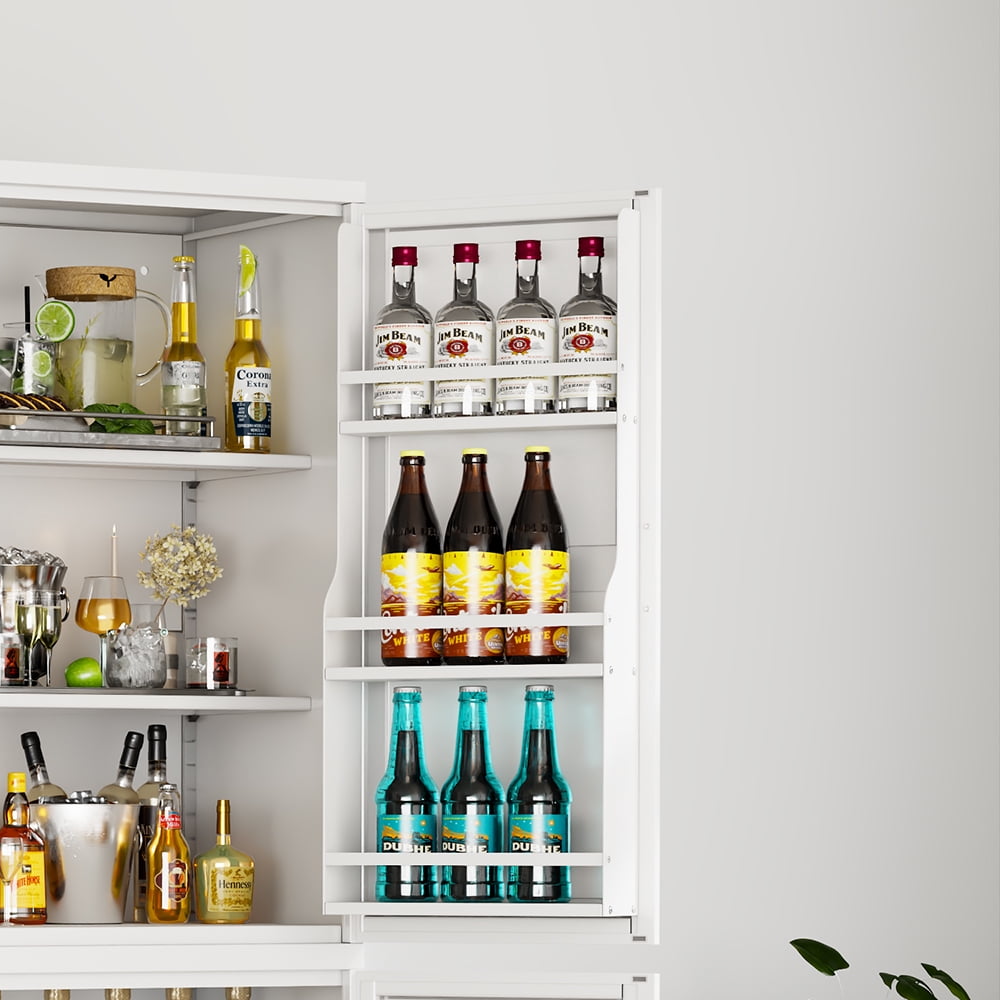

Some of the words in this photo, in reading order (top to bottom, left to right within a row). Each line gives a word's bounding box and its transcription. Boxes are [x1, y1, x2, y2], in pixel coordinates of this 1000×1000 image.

[376, 333, 390, 347] JIM
[392, 330, 421, 345] BEAM
[437, 330, 451, 344] JIM
[453, 328, 483, 343] BEAM
[499, 327, 513, 342] JIM
[515, 325, 545, 340] BEAM
[562, 325, 576, 339] JIM
[579, 322, 609, 337] BEAM
[393, 632, 430, 647] WHTE
